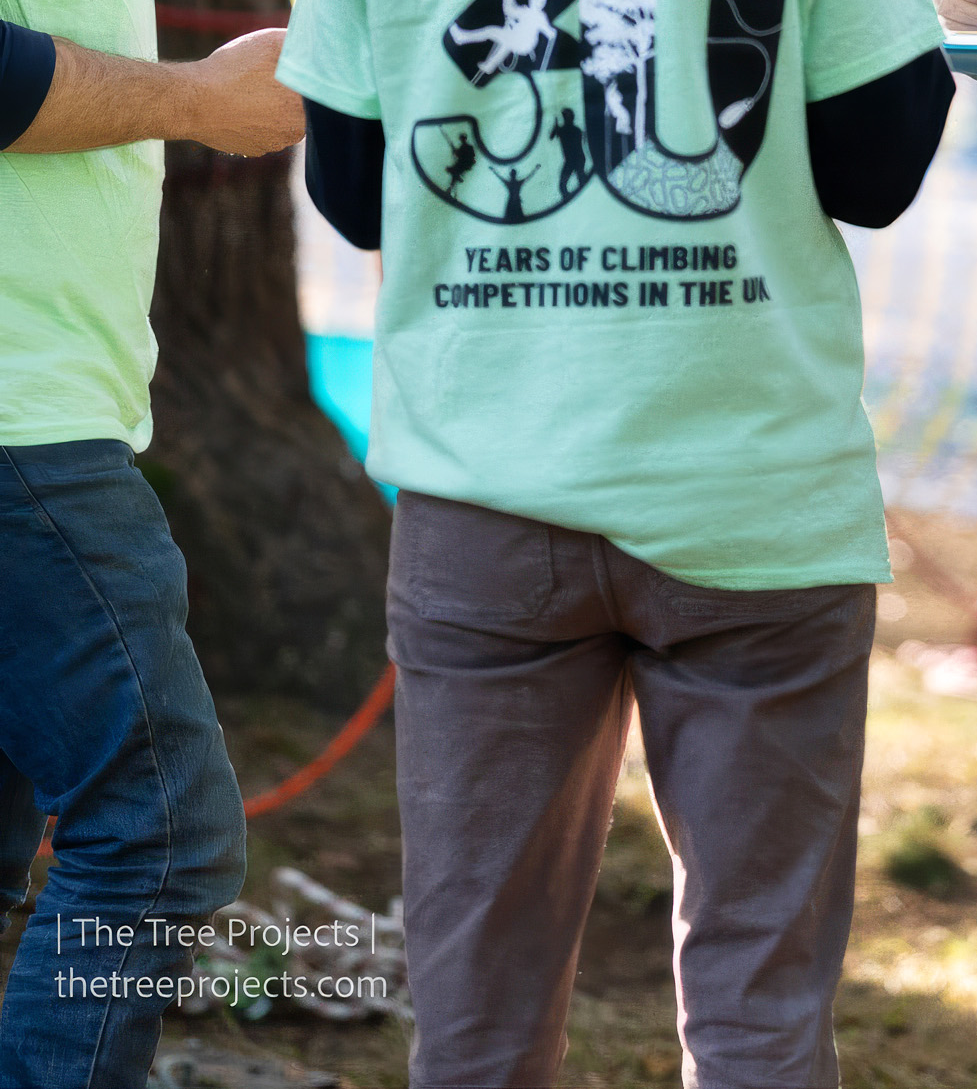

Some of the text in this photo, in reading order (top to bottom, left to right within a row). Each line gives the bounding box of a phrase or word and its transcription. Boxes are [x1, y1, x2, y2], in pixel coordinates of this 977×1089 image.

[465, 244, 738, 272] YEARS OF CLIMBING
[434, 282, 629, 309] COMPETITIONS
[639, 282, 669, 306] IN
[679, 280, 734, 307] THE
